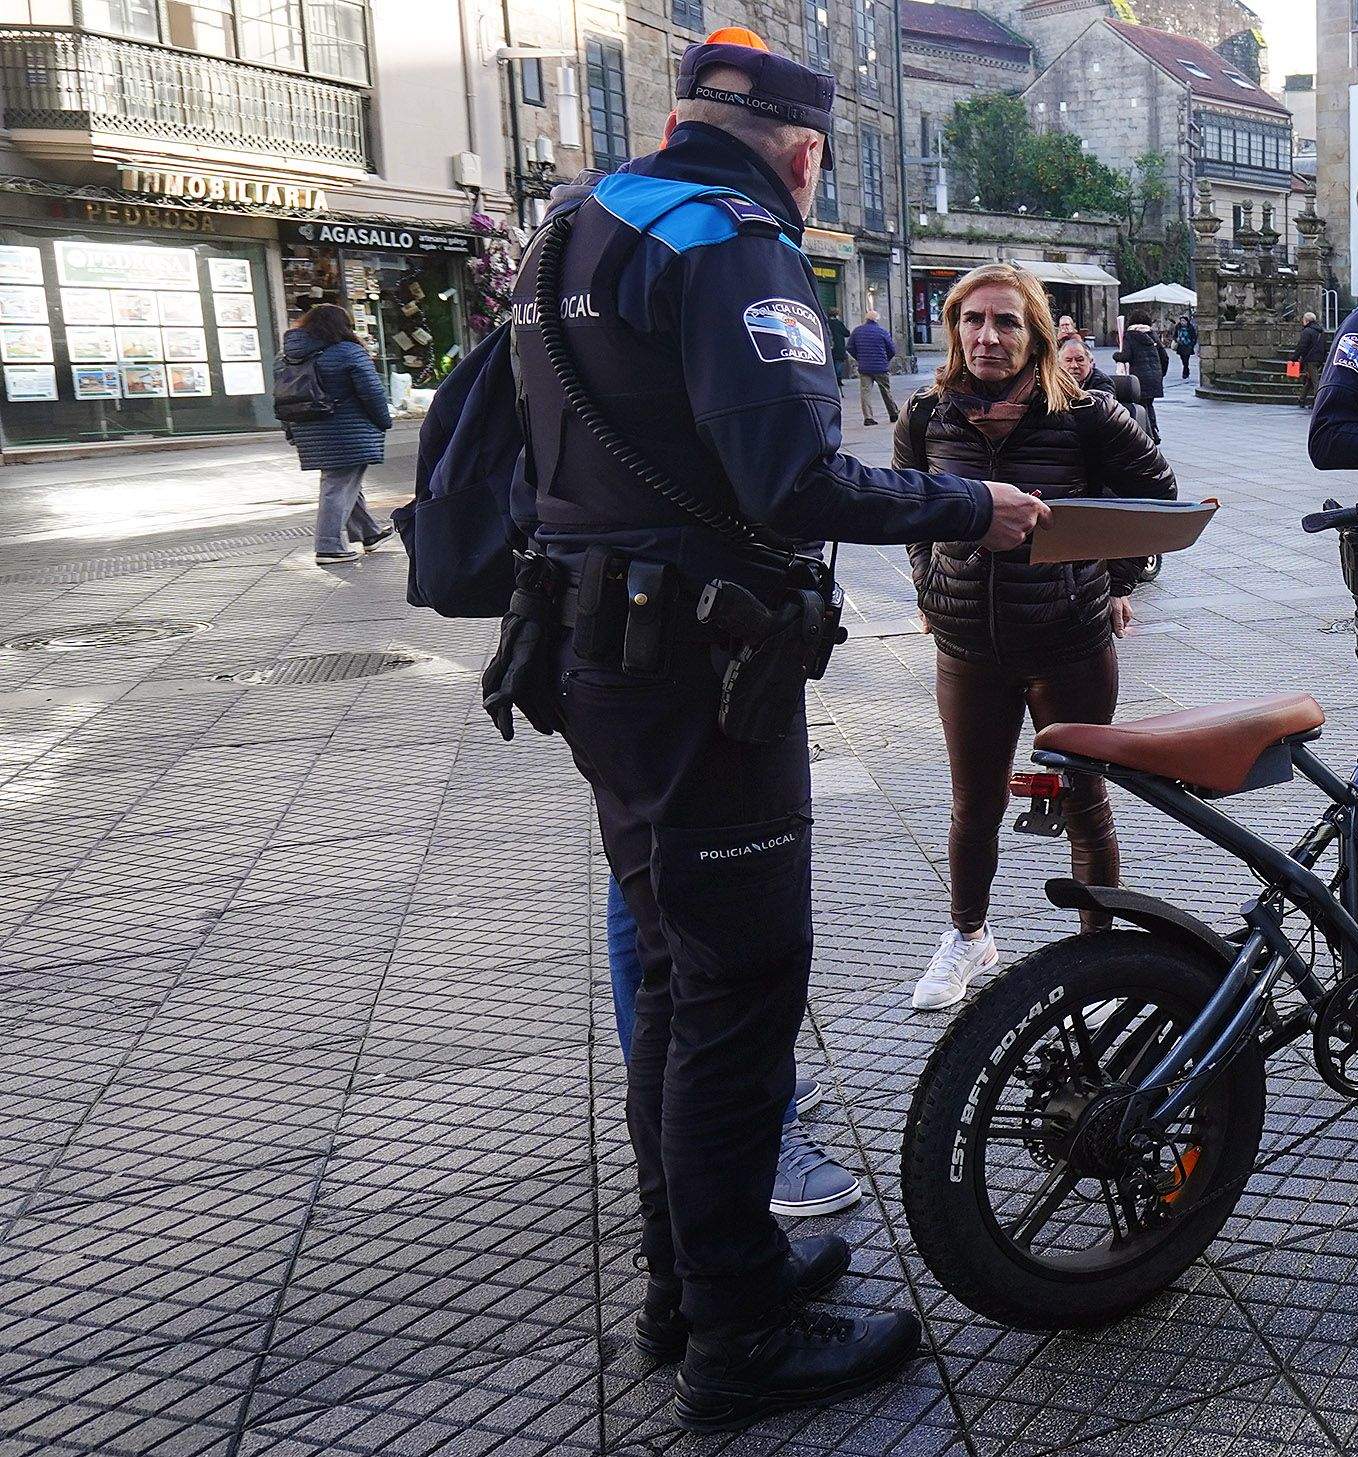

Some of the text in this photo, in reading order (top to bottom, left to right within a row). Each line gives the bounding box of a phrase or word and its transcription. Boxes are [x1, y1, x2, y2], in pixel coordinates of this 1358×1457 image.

[746, 99, 780, 114] LOCAL
[122, 168, 330, 211] INMOBILIARIA
[86, 203, 216, 233] PEDROSA
[320, 225, 413, 249] AGASALLO
[560, 293, 600, 320] OCAL
[699, 833, 796, 860] POLICIA LOCAL
[949, 985, 1065, 1184] CST BFT 20x4.0
